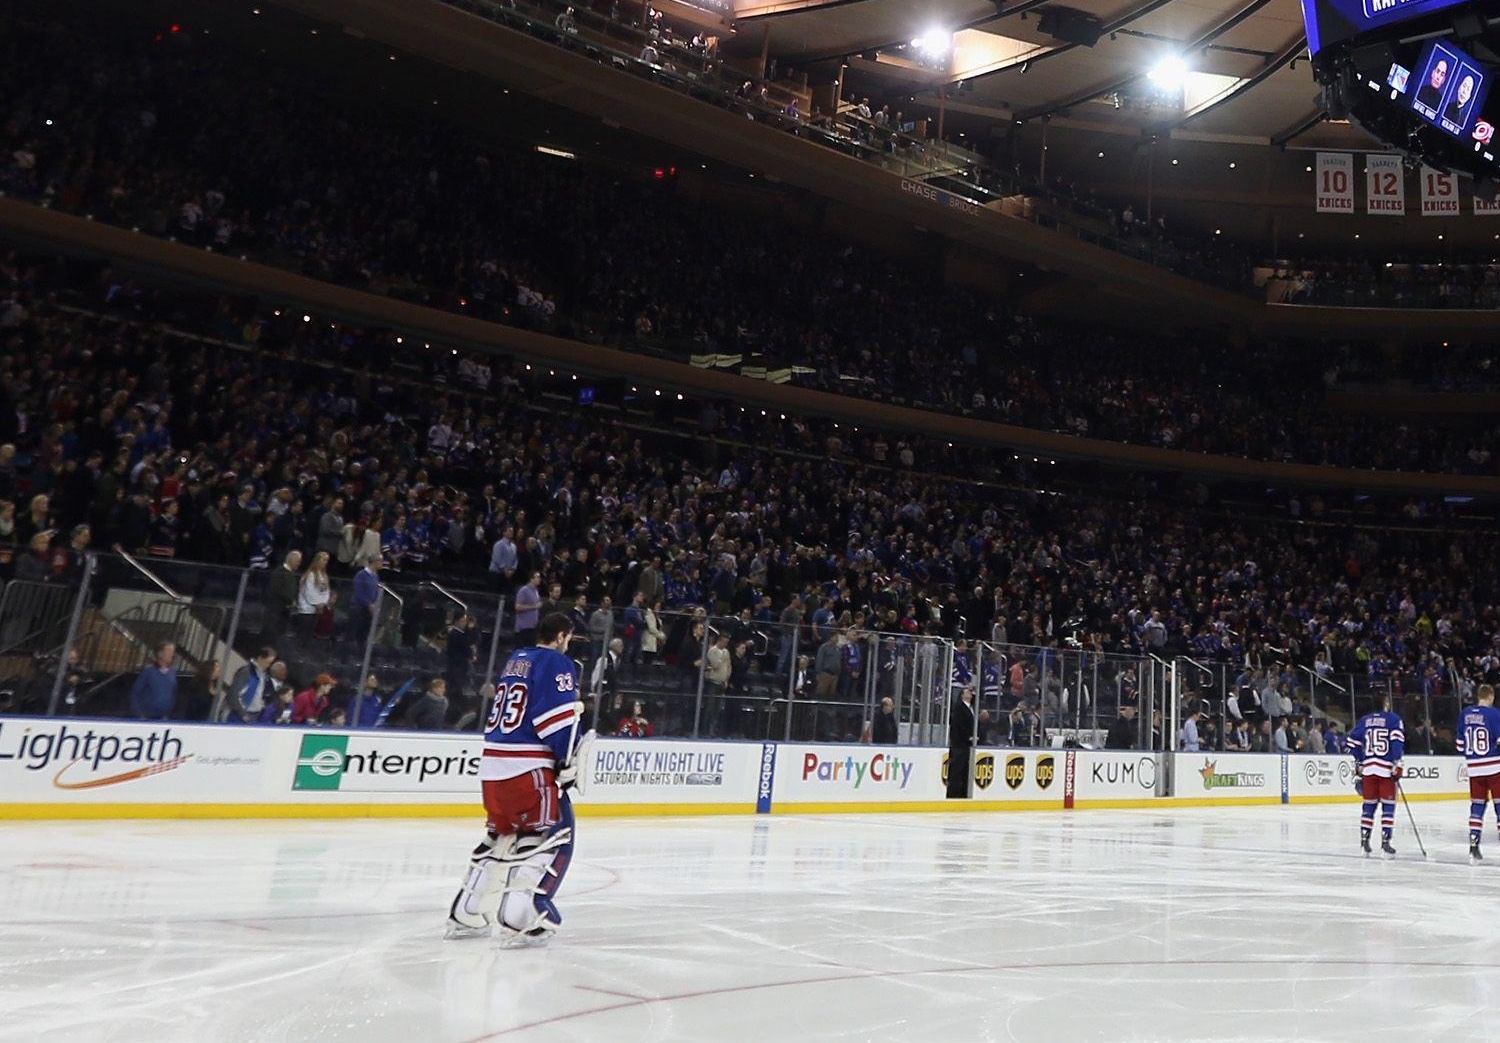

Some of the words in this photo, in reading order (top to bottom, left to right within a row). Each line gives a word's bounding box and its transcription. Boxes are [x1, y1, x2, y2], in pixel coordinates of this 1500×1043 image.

[1322, 170, 1348, 194] 10
[1373, 172, 1398, 196] 12
[1427, 173, 1452, 197] 15
[1318, 197, 1352, 208] KNICKS
[1369, 199, 1402, 211] KNICKS
[1423, 199, 1457, 212] KNICKS
[555, 673, 575, 693] 33
[484, 682, 529, 736] 33
[1364, 728, 1389, 757] 15
[1465, 726, 1490, 756] 18
[311, 748, 481, 784] enterpris
[595, 750, 651, 772] HOCKEY
[654, 752, 696, 773] NIGHT
[697, 753, 725, 774] LIVE
[760, 743, 775, 799] Reebok
[975, 761, 994, 787] ups
[1006, 761, 1024, 787] ups
[1036, 761, 1054, 787] ups
[1066, 750, 1075, 798] Reebok
[593, 772, 639, 786] SATURDAY
[639, 772, 672, 786] NIGHTS
[673, 773, 685, 786] ON
